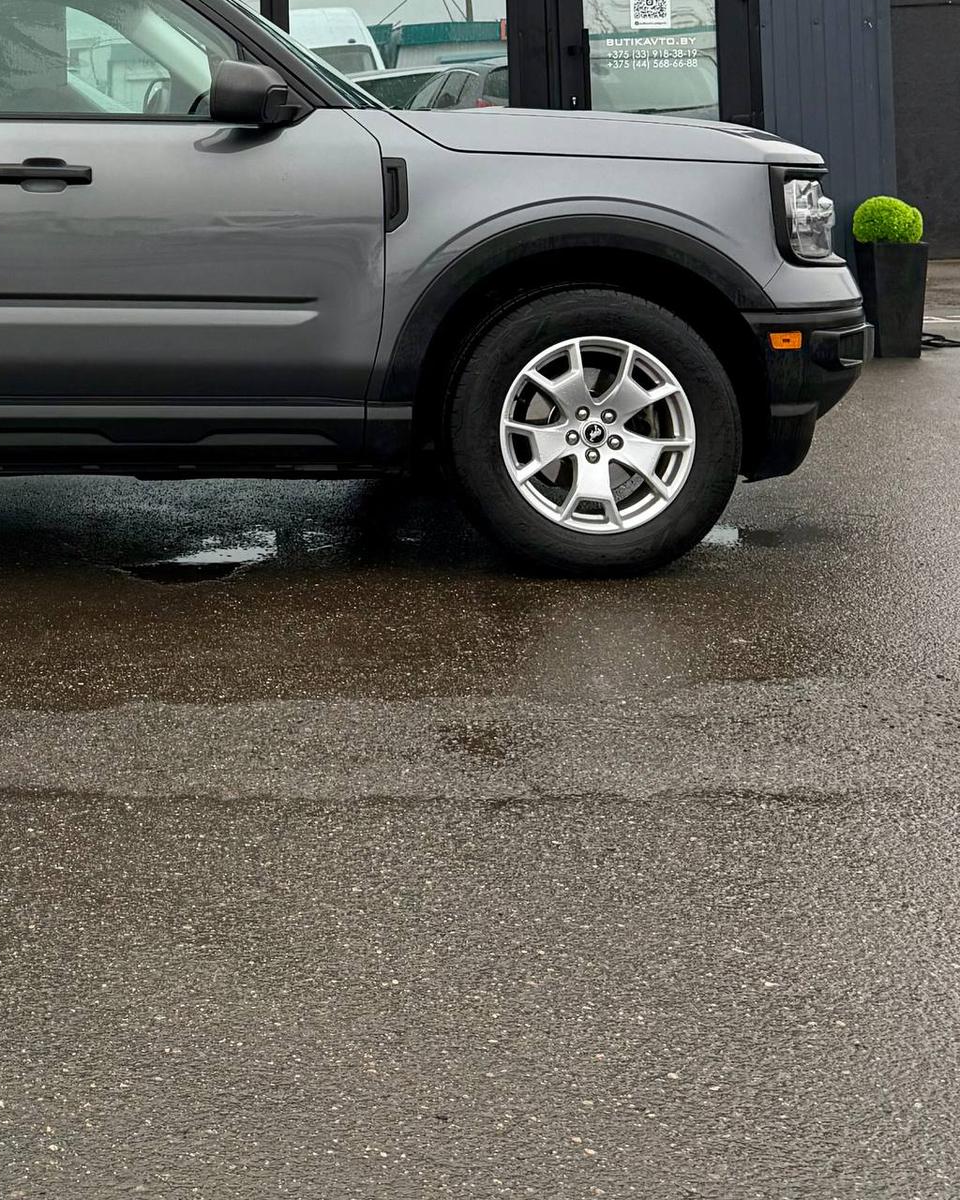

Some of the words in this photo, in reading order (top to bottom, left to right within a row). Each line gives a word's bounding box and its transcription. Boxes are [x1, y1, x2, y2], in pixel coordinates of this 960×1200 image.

[606, 37, 696, 46] BUTIKAVTO.BY
[607, 49, 629, 59] +375
[632, 49, 650, 60] (33)
[652, 48, 697, 58] 918-38-19
[607, 59, 629, 69] +375
[632, 59, 650, 70] (44)
[653, 58, 698, 68] 568-66-88
